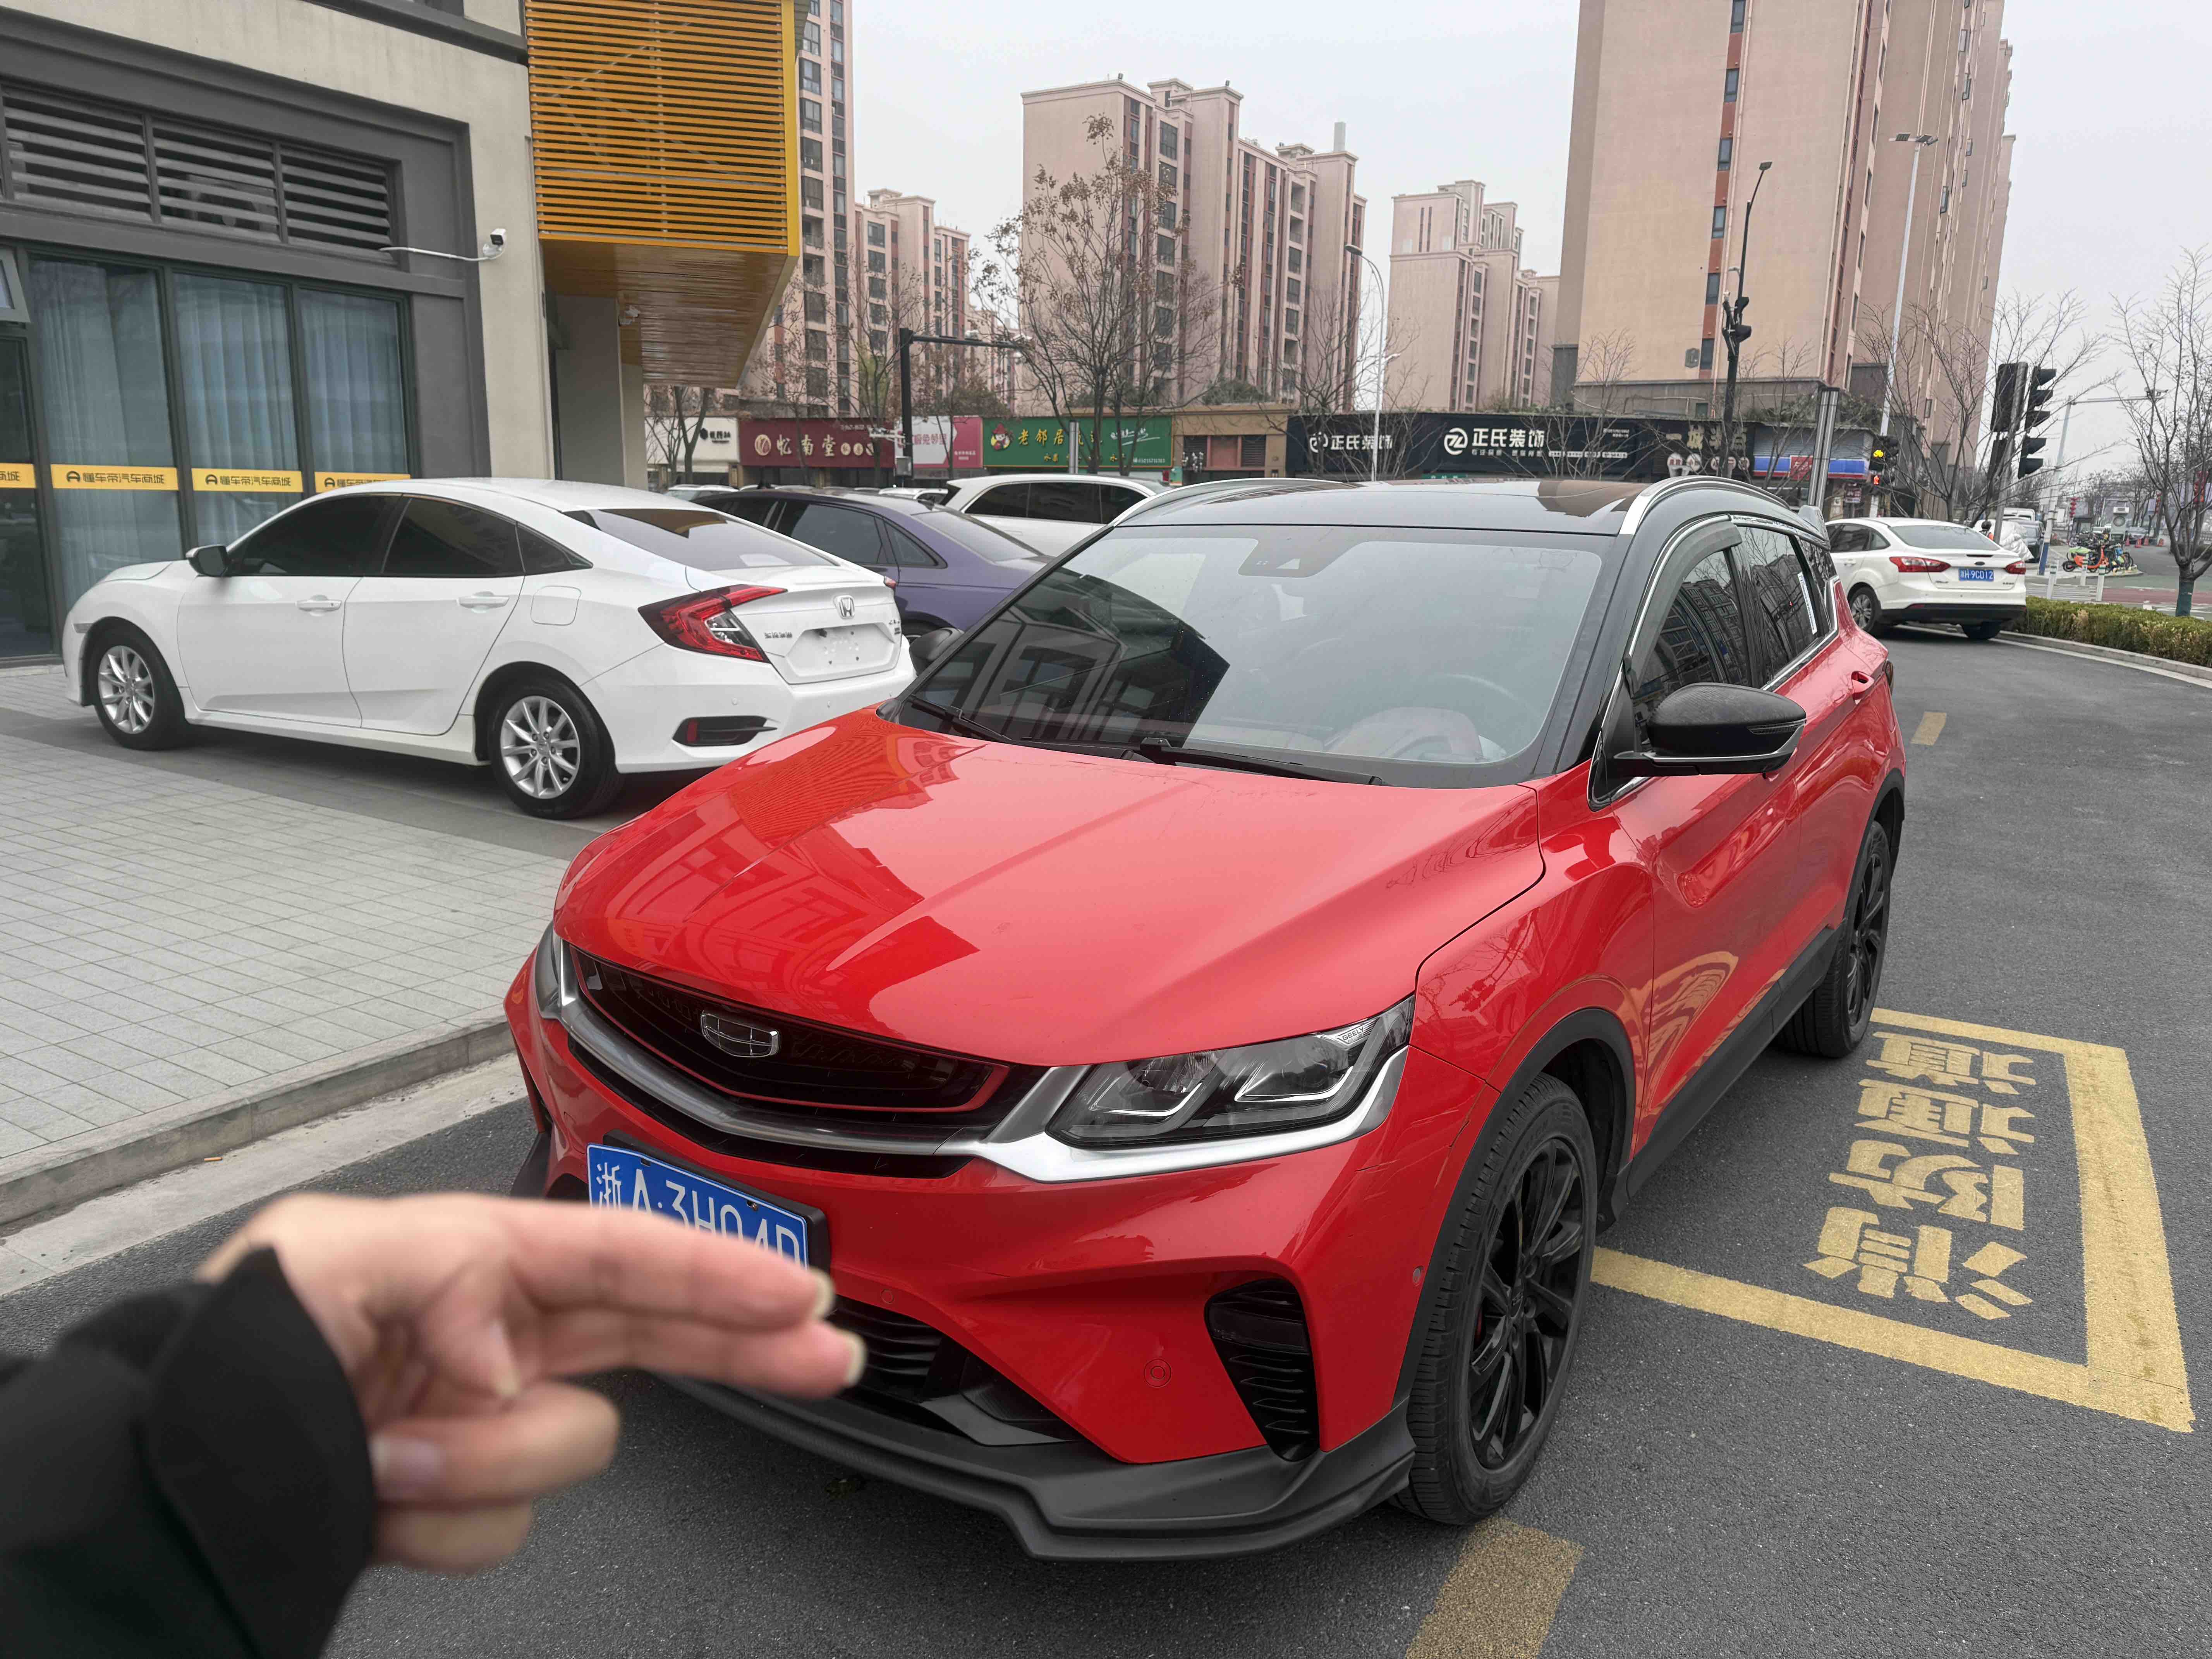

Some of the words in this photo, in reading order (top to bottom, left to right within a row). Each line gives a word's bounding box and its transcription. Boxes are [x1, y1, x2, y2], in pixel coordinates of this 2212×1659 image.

[1330, 434, 1393, 450] 正氏装饰
[1472, 428, 1545, 448] 正氏装饰
[82, 472, 165, 484] 懂车帝汽车商城
[220, 476, 291, 486] 懂车帝汽车商城
[1342, 1026, 1364, 1041] GEELY
[1803, 1031, 2036, 1319] 消防通道
